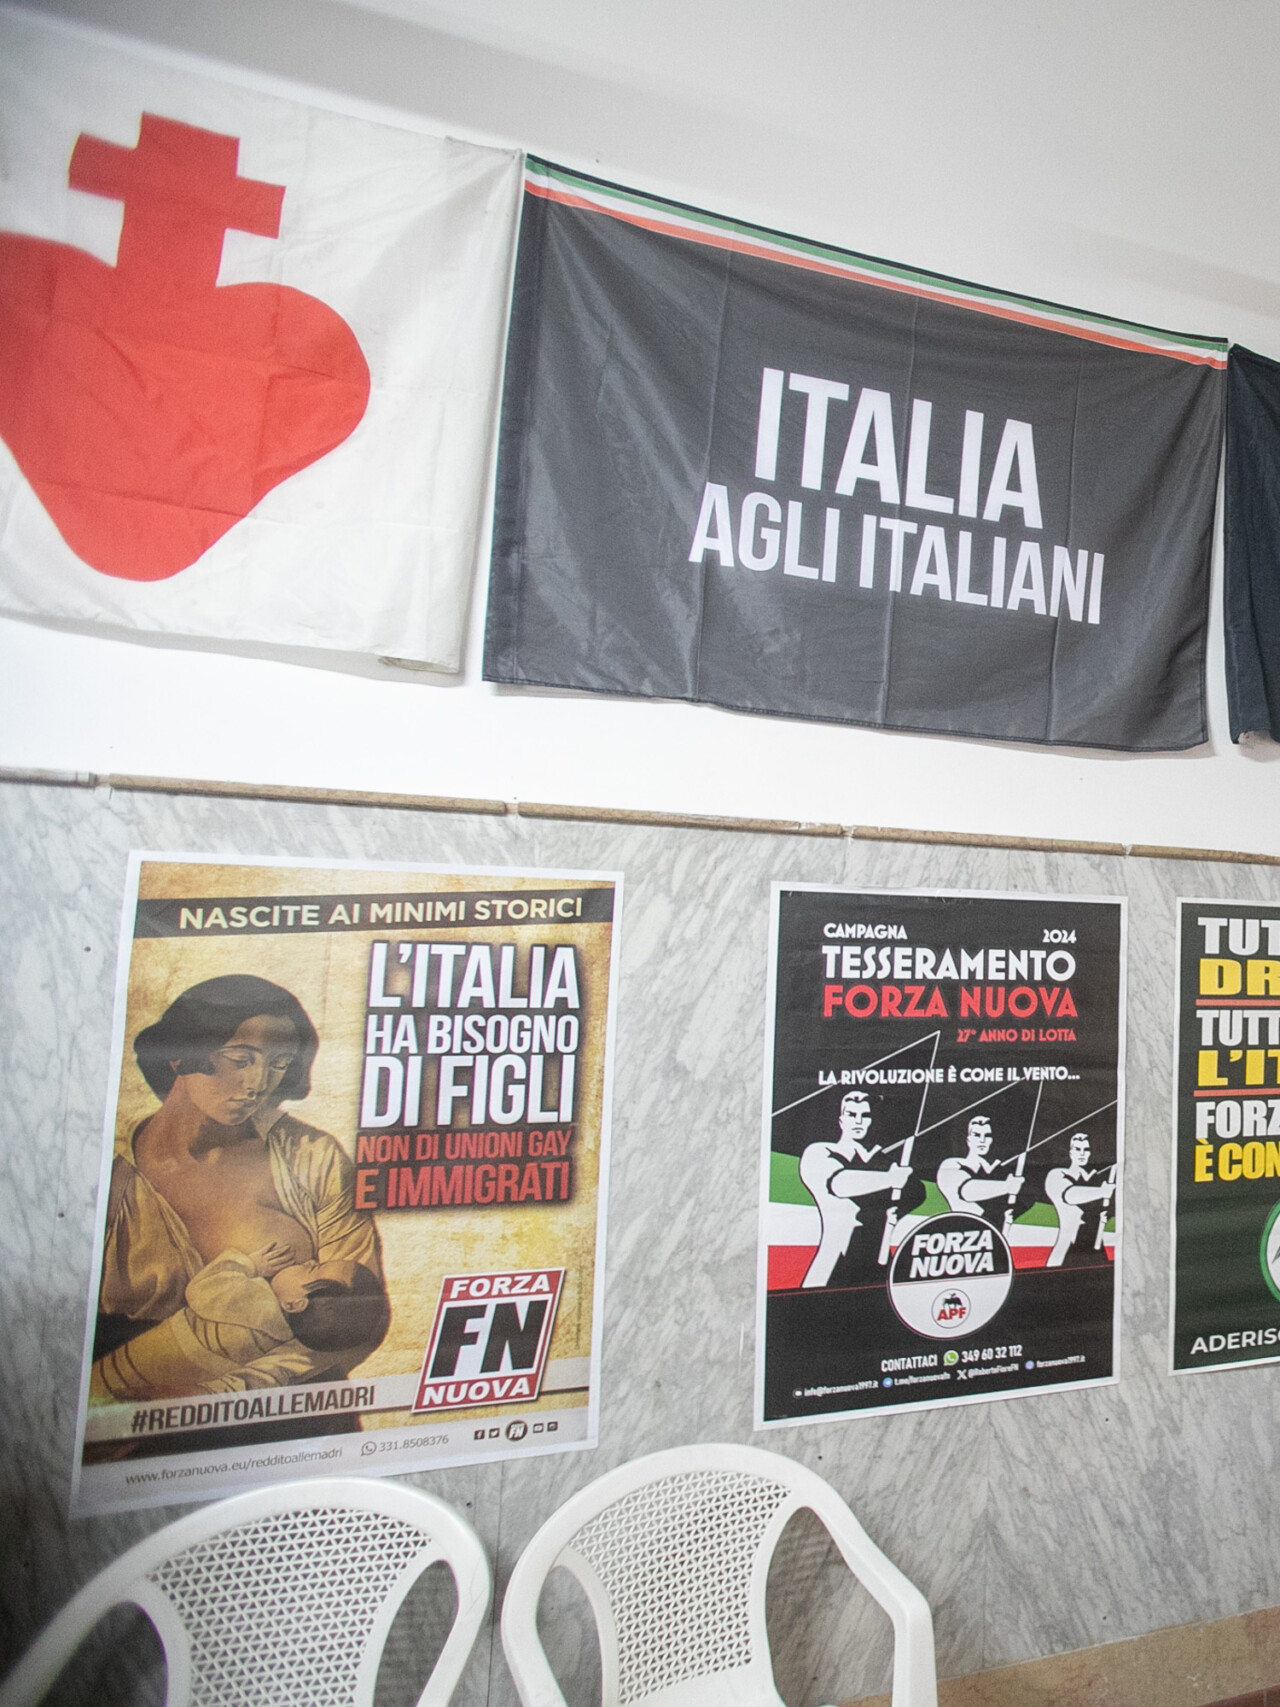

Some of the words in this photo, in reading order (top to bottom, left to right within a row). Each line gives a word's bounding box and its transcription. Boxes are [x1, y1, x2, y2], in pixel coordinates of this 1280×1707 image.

[754, 366, 1043, 529] ITALIA
[688, 481, 841, 584] AGLI
[858, 513, 1105, 625] ITALIANI
[178, 905, 319, 930] NASCITE
[328, 902, 360, 926] AI
[369, 900, 465, 924] MINIMI
[474, 897, 583, 920] STORICI
[823, 923, 908, 939] CAMPAGNA
[1042, 929, 1077, 944] 2024
[368, 941, 581, 1010] L'ITALIA
[822, 945, 1076, 982] TESSERAMENTO
[822, 984, 948, 1018] FORZA
[960, 986, 1078, 1018] NUOVA
[365, 1014, 418, 1055] HA
[427, 1013, 579, 1054] BISOGNO
[979, 1029, 1018, 1042] ANNO
[1021, 1029, 1036, 1041] DI
[1039, 1028, 1076, 1041] LOTTA
[359, 1056, 422, 1129] DI
[436, 1053, 575, 1126] FIGLI
[818, 1070, 837, 1085] LA
[840, 1068, 944, 1086] RIVOLUZIONE
[948, 1065, 957, 1083] È
[960, 1067, 1004, 1082] COME
[1007, 1067, 1020, 1081] IL
[1022, 1066, 1080, 1081] VENTO...
[356, 1135, 410, 1164] NON
[415, 1133, 439, 1161] DI
[444, 1131, 523, 1160] UNIONI
[528, 1129, 572, 1157] GAY
[1194, 1138, 1213, 1182] È
[354, 1168, 379, 1210] E
[386, 1161, 570, 1208] IMMIGRATI
[911, 1229, 993, 1256] FORZA
[909, 1251, 994, 1279] NUOVA
[450, 1274, 550, 1299] FORZA
[937, 1307, 967, 1321] APF
[429, 1299, 549, 1379] FN
[881, 1354, 938, 1372] CONTATTACI
[961, 1349, 980, 1363] 349
[981, 1348, 994, 1360] 60
[995, 1346, 1007, 1359] 32
[1008, 1344, 1023, 1357] 112
[421, 1376, 530, 1406] NUOVA
[131, 1385, 375, 1433] #REDDITOALLEMADRI
[125, 1447, 343, 1486] www.forzanuova.eu/redditoallemadri
[379, 1434, 449, 1452] 331.8508376
